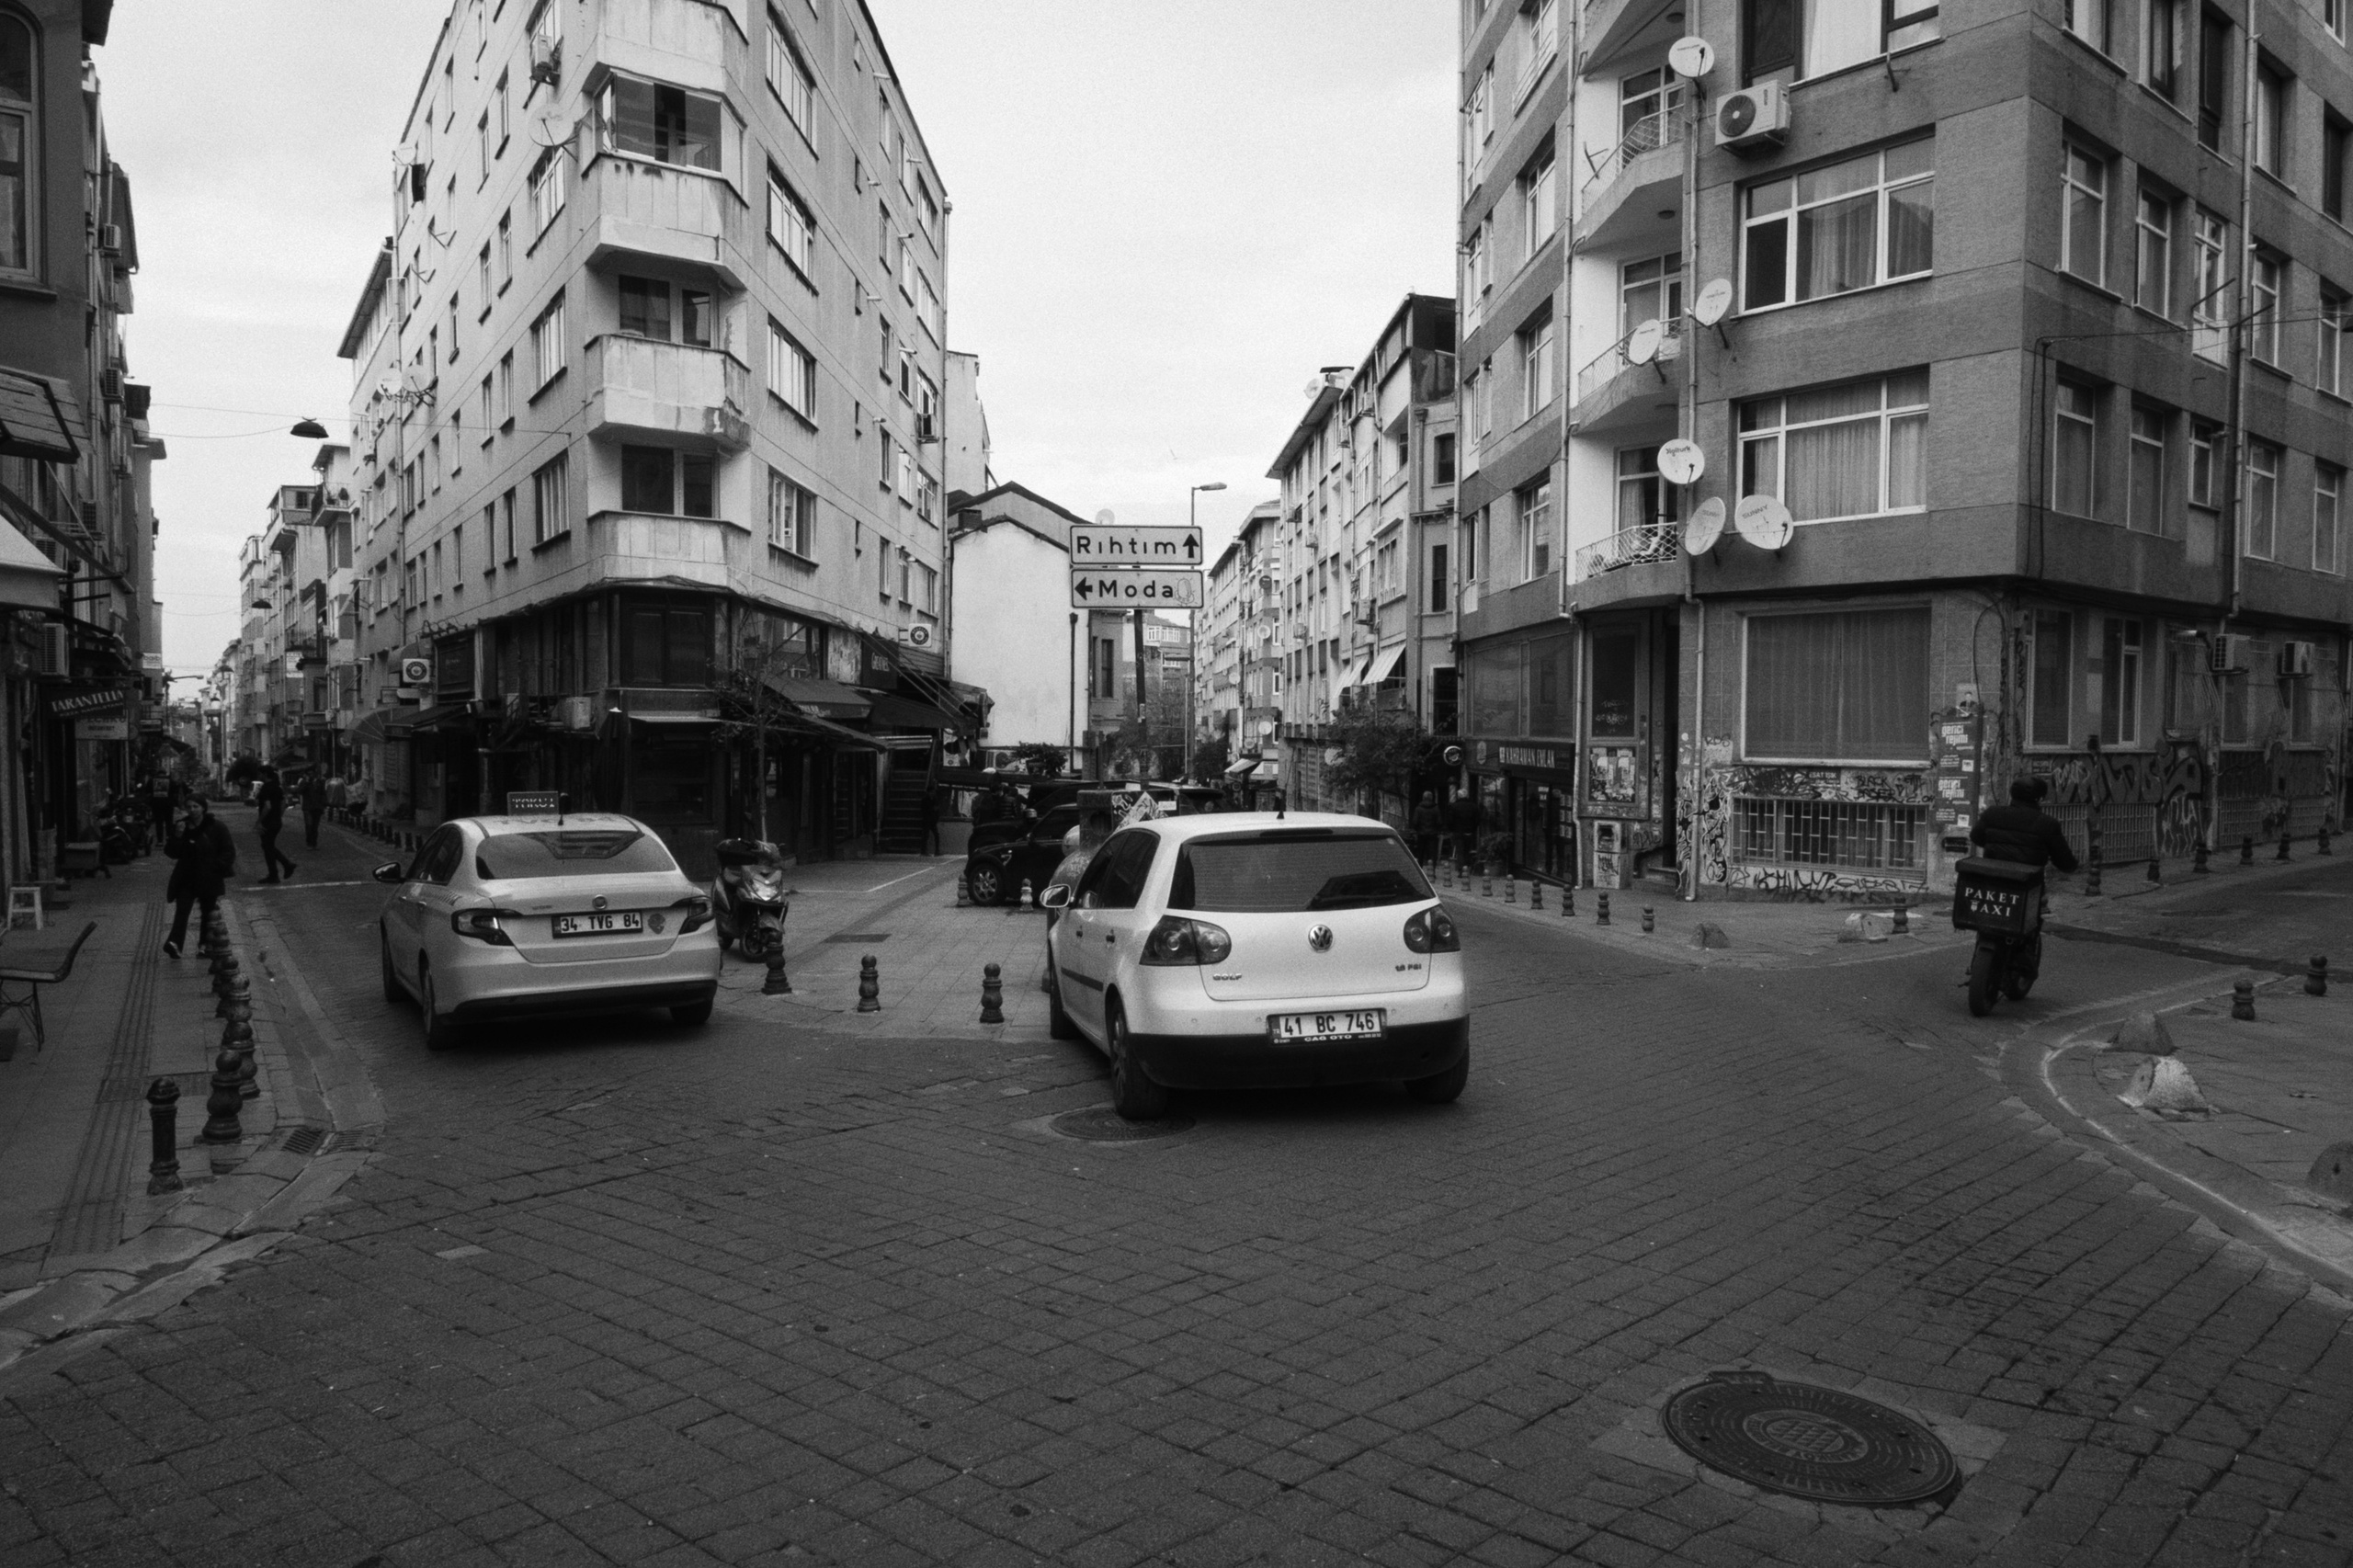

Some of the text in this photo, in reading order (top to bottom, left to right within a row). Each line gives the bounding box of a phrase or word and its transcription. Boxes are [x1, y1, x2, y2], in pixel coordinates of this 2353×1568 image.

[1742, 504, 1768, 519] SUNNY
[1077, 536, 1176, 554] Rıhtım
[1098, 580, 1173, 597] Moda
[51, 689, 123, 711] TARANTELLA
[1506, 747, 1536, 767] KAHRAMAN
[1536, 748, 1555, 768] EMLAK
[1964, 887, 2019, 904] PAKET
[561, 914, 639, 932] 34 TVG 84
[1212, 972, 1242, 981] GOLF
[1285, 1013, 1374, 1035] 41 BC 746
